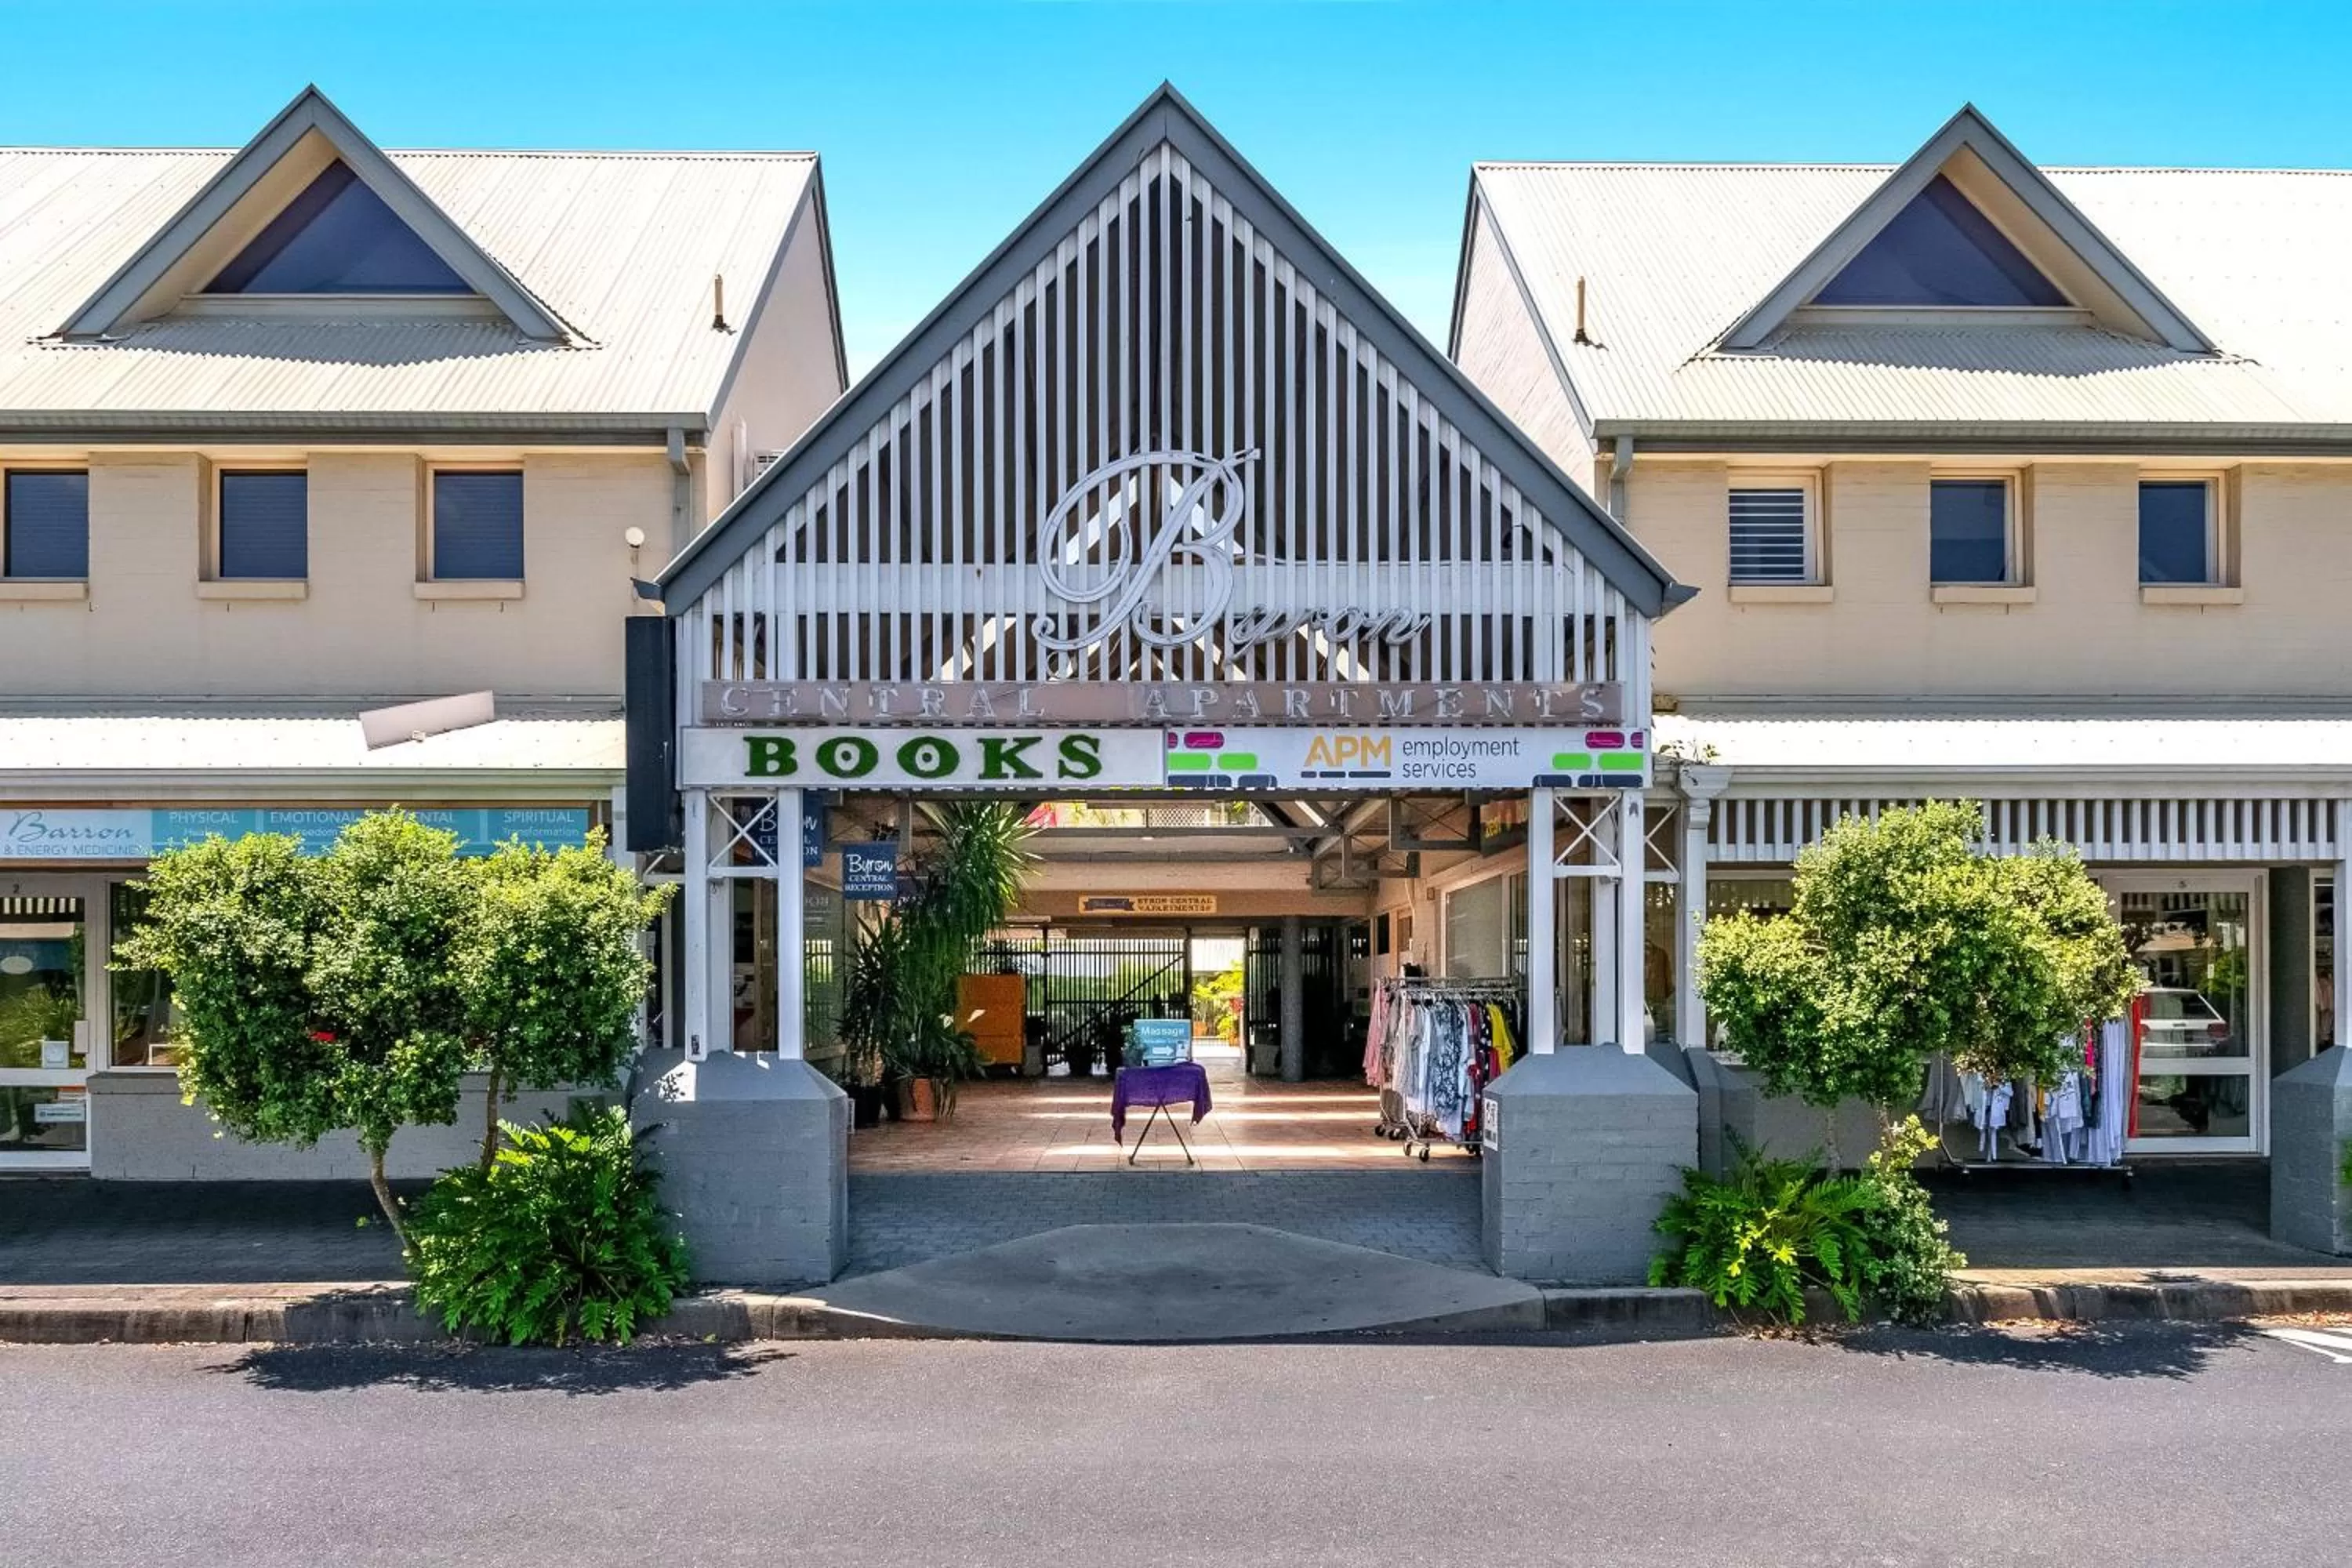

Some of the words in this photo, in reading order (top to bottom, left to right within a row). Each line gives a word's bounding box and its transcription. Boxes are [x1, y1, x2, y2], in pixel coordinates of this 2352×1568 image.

[1032, 448, 1432, 666] Byron
[720, 687, 1046, 718] CENTRAL
[1142, 686, 1606, 720] APARTMENTS
[743, 734, 1102, 780] BOOKS
[1303, 734, 1392, 768] APM
[1403, 736, 1520, 759] employment
[1402, 759, 1476, 778] services
[9, 811, 135, 842] Barron
[169, 811, 238, 823] PHYSICAL
[270, 811, 358, 823] EMOTIONAL
[504, 811, 574, 822] SPIRITUAL
[17, 845, 68, 855] ENERGY
[846, 854, 893, 876] Byron
